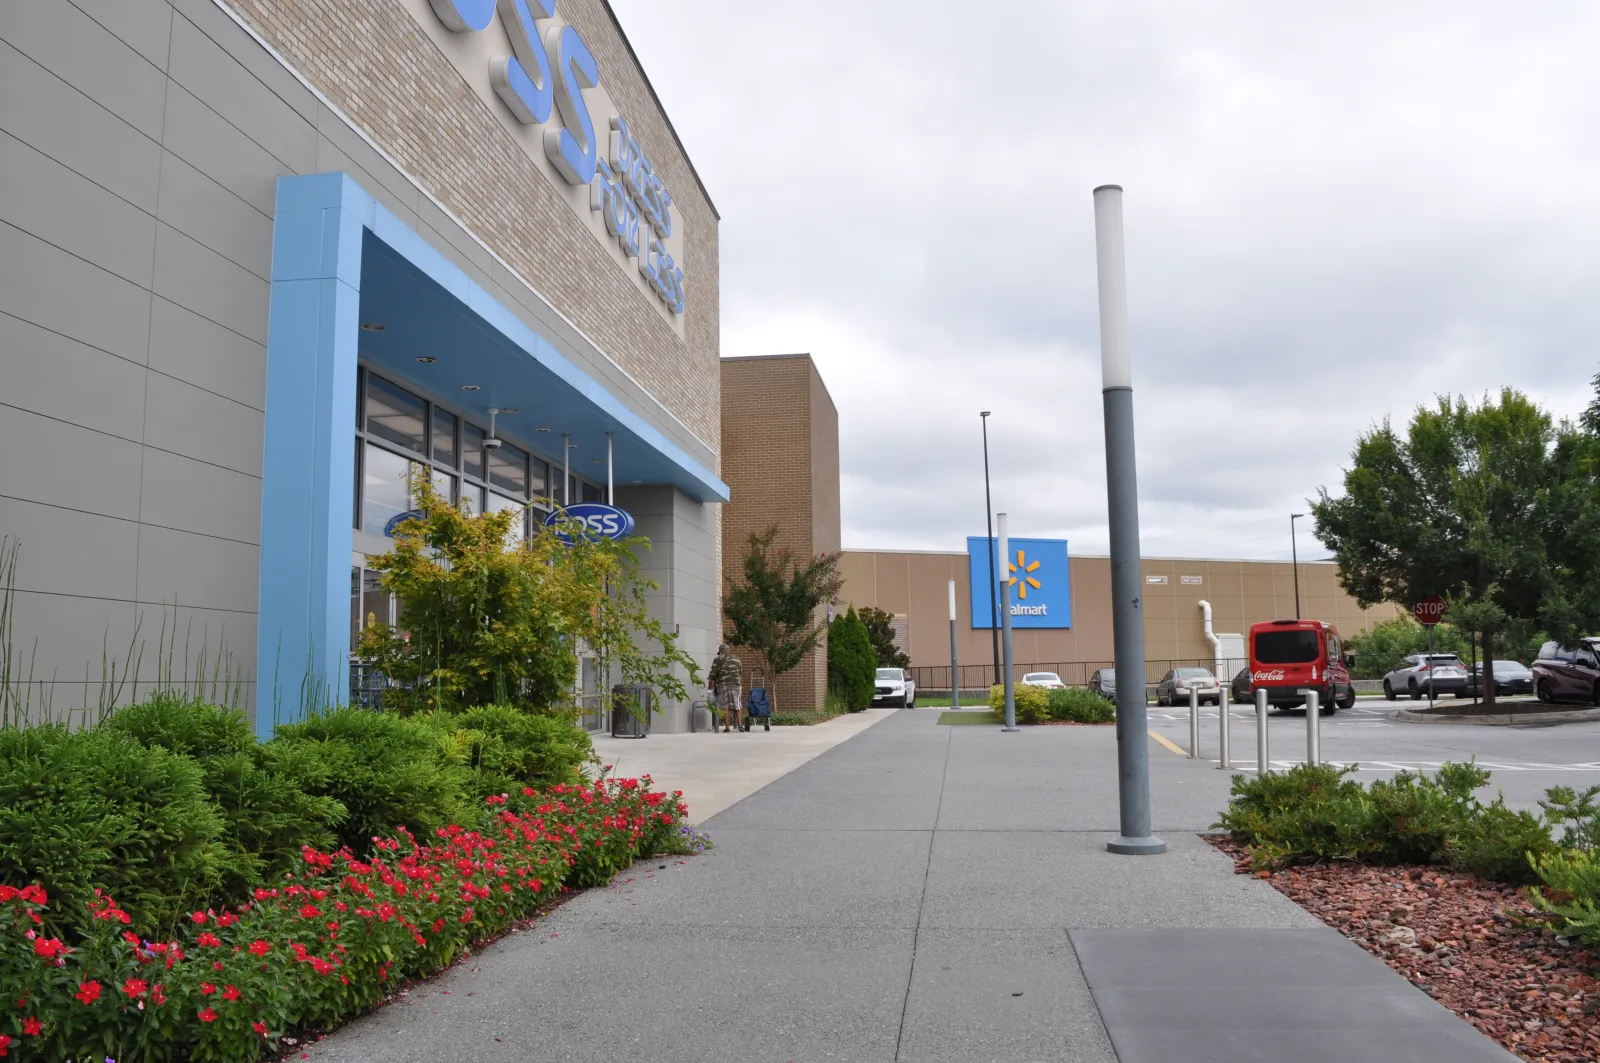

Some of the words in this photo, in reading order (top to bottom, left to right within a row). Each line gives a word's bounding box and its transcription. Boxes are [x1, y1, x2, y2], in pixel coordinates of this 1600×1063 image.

[609, 115, 672, 238] DRESS
[590, 157, 640, 258] FOR
[638, 224, 684, 315] LESS
[998, 603, 1048, 616] almart
[1415, 602, 1445, 615] STOP
